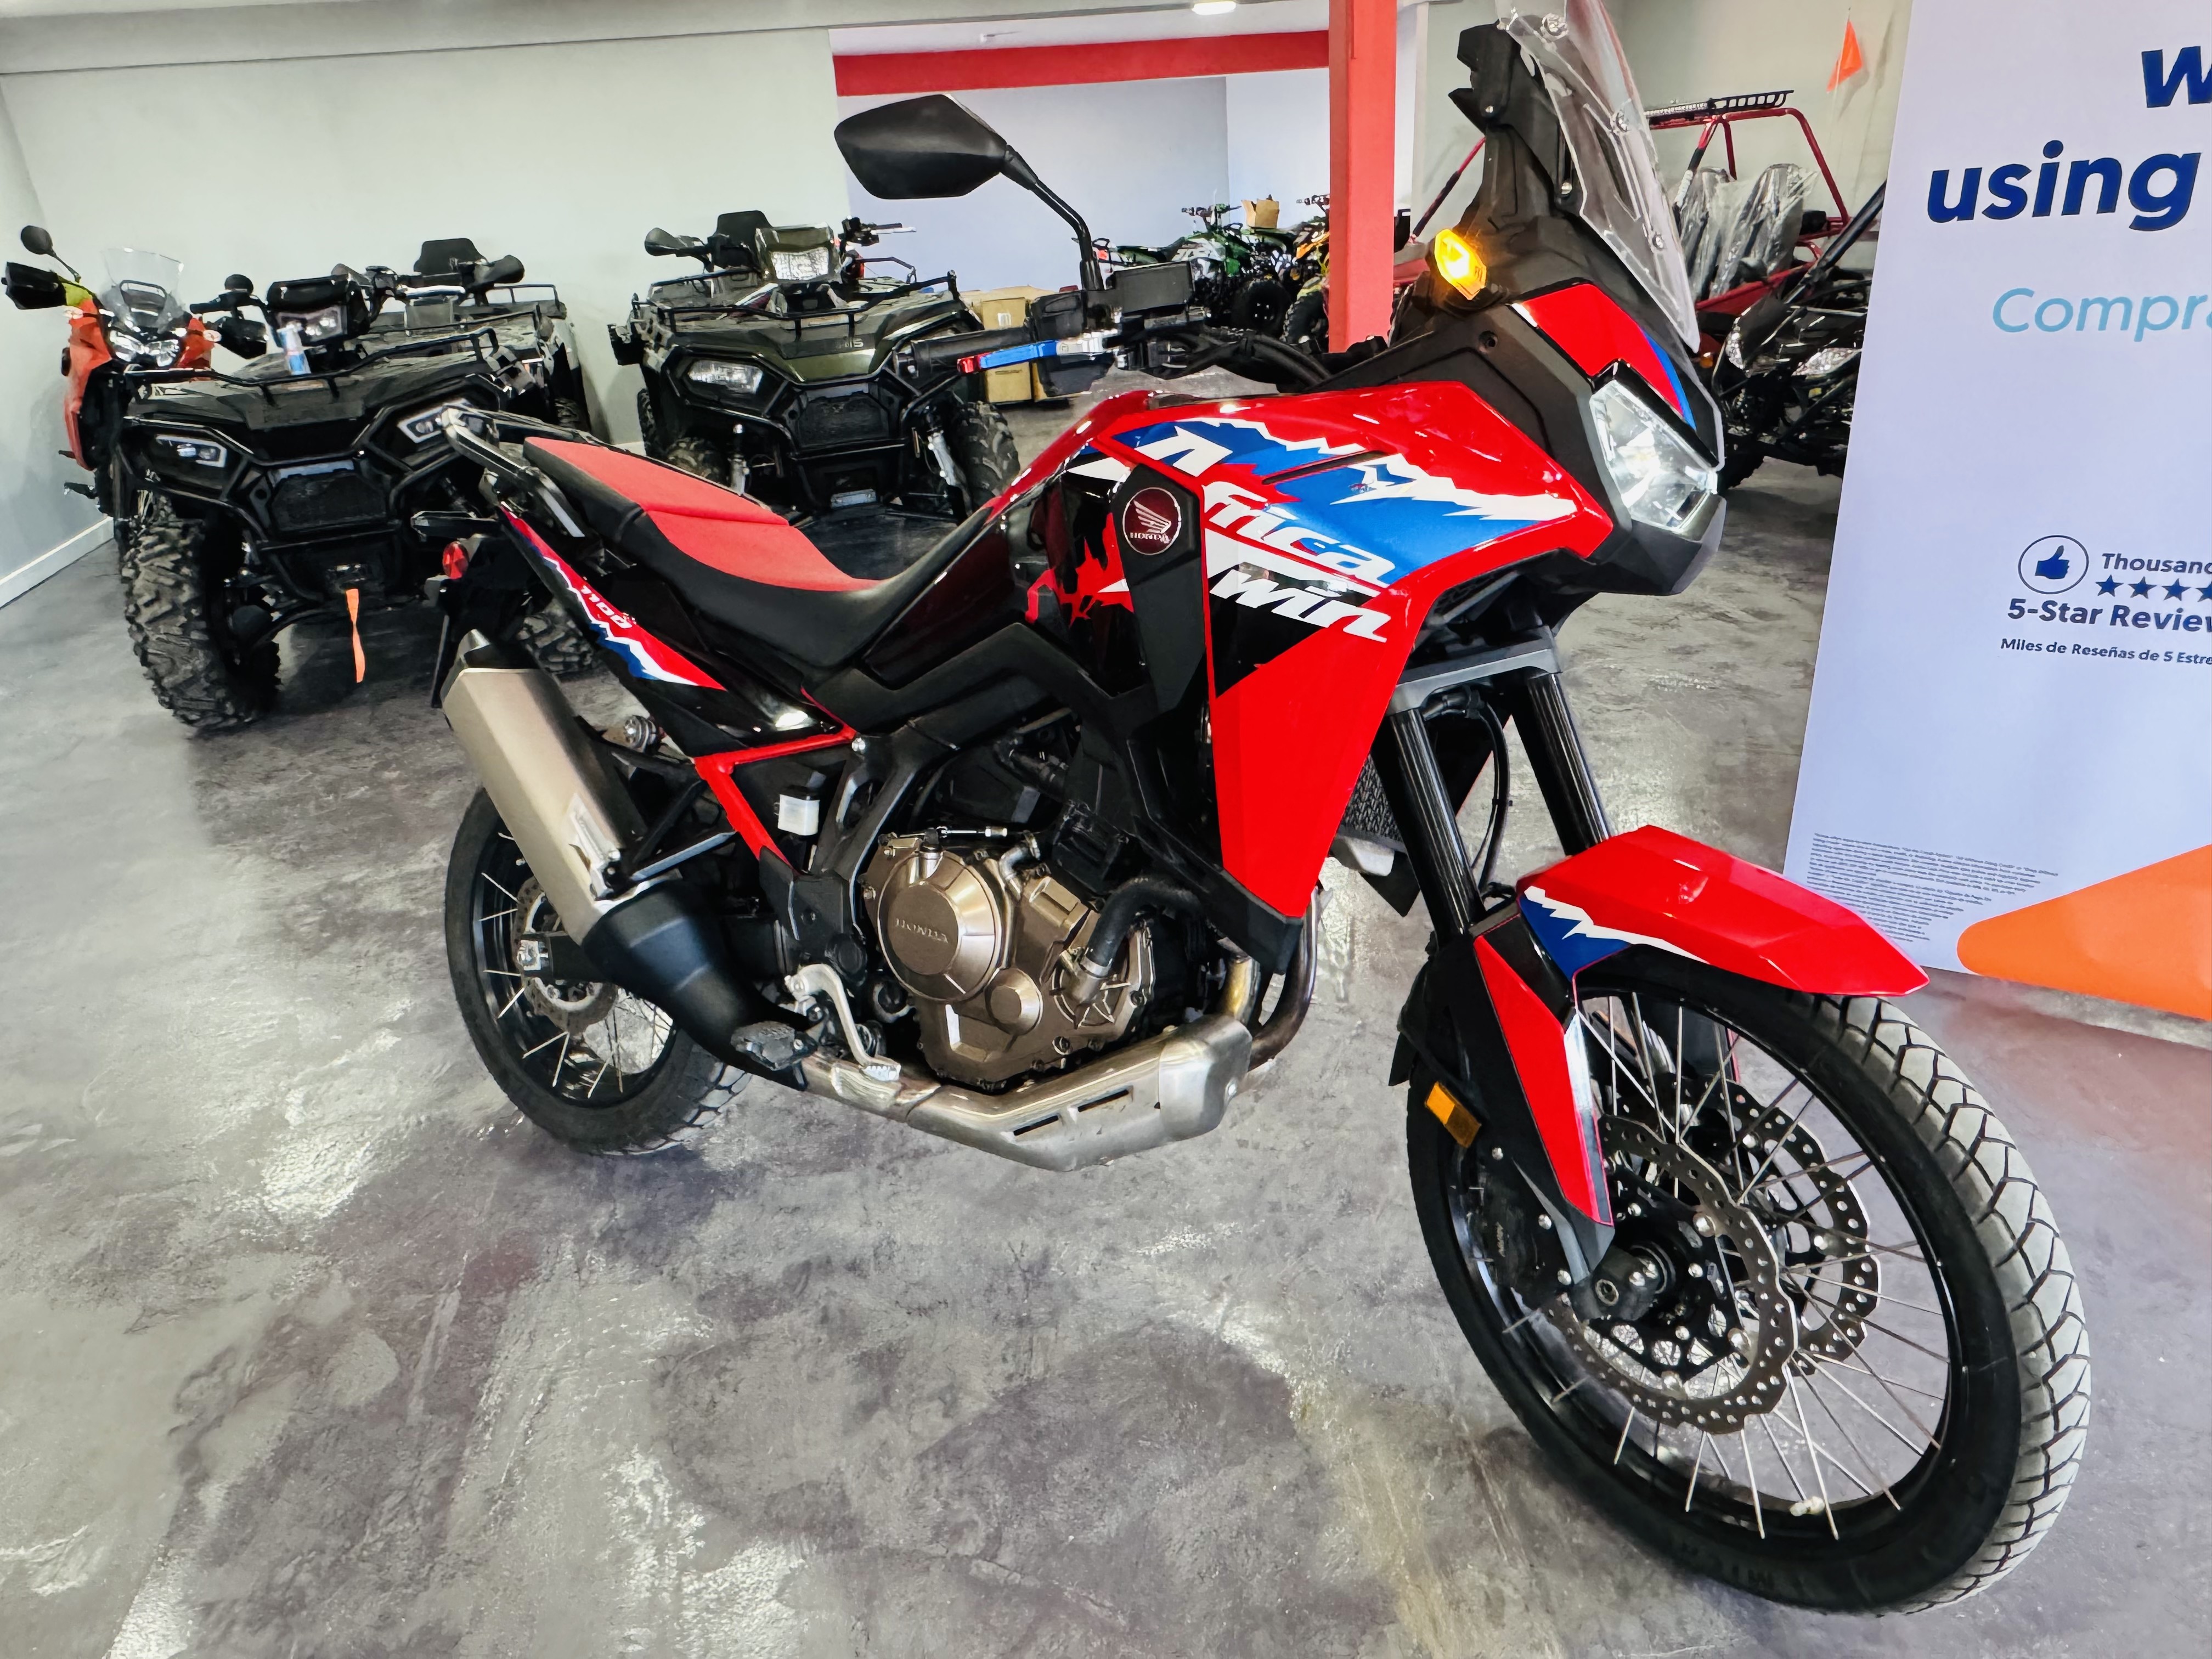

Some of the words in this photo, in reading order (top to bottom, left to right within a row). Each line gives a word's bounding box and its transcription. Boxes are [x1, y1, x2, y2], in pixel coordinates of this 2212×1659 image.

[1927, 140, 2201, 231] using
[1993, 287, 2212, 342] Compr
[1130, 532, 1170, 544] HONDA
[581, 585, 633, 629] 1100
[2007, 598, 2103, 624] 5-Star
[2110, 605, 2212, 633] Revie
[2001, 638, 2042, 652] Miles
[2046, 641, 2067, 653] de
[2072, 644, 2135, 659] Reseñas
[2139, 650, 2159, 661] de
[2164, 651, 2174, 662] 5
[895, 918, 949, 944] HONDA
